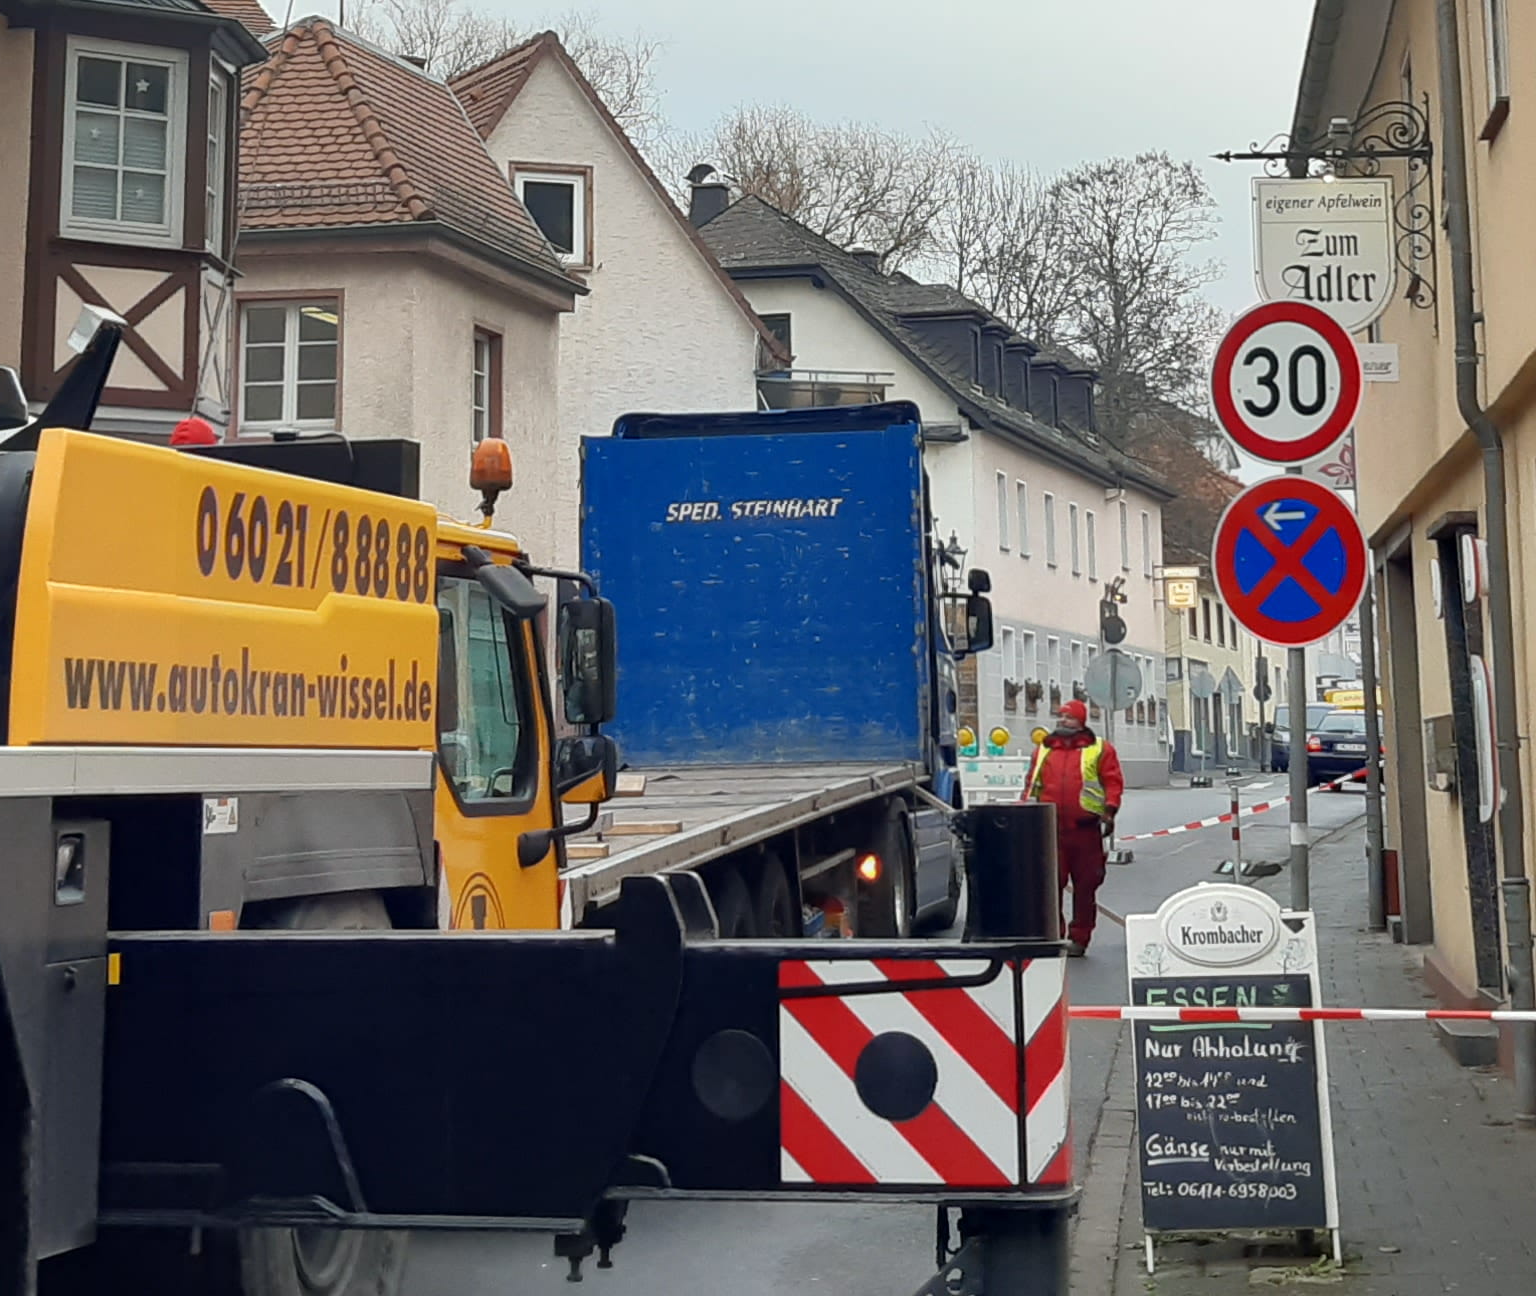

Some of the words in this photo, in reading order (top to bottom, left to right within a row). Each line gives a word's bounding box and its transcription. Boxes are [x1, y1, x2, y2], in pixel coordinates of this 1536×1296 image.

[1265, 195, 1314, 214] eigener
[1318, 193, 1382, 213] Apfelwein
[1295, 229, 1359, 257] Zum
[1281, 264, 1377, 302] Adler
[1243, 344, 1327, 418] 30
[666, 502, 722, 522] SPED.
[730, 498, 843, 520] STEINHART
[64, 646, 432, 722] www.autokran-wissel.de
[1181, 924, 1263, 945] Krombacher
[1146, 986, 1258, 1008] ESSEN
[1145, 1038, 1183, 1058] Nur
[1192, 1034, 1300, 1064] Abholung
[1180, 1095, 1203, 1109] bis
[1145, 1133, 1210, 1158] Gänse
[1220, 1145, 1248, 1156] nur
[1249, 1139, 1277, 1157] mit
[1214, 1158, 1312, 1177] Vorbestellung
[1143, 1181, 1174, 1197] Tel:
